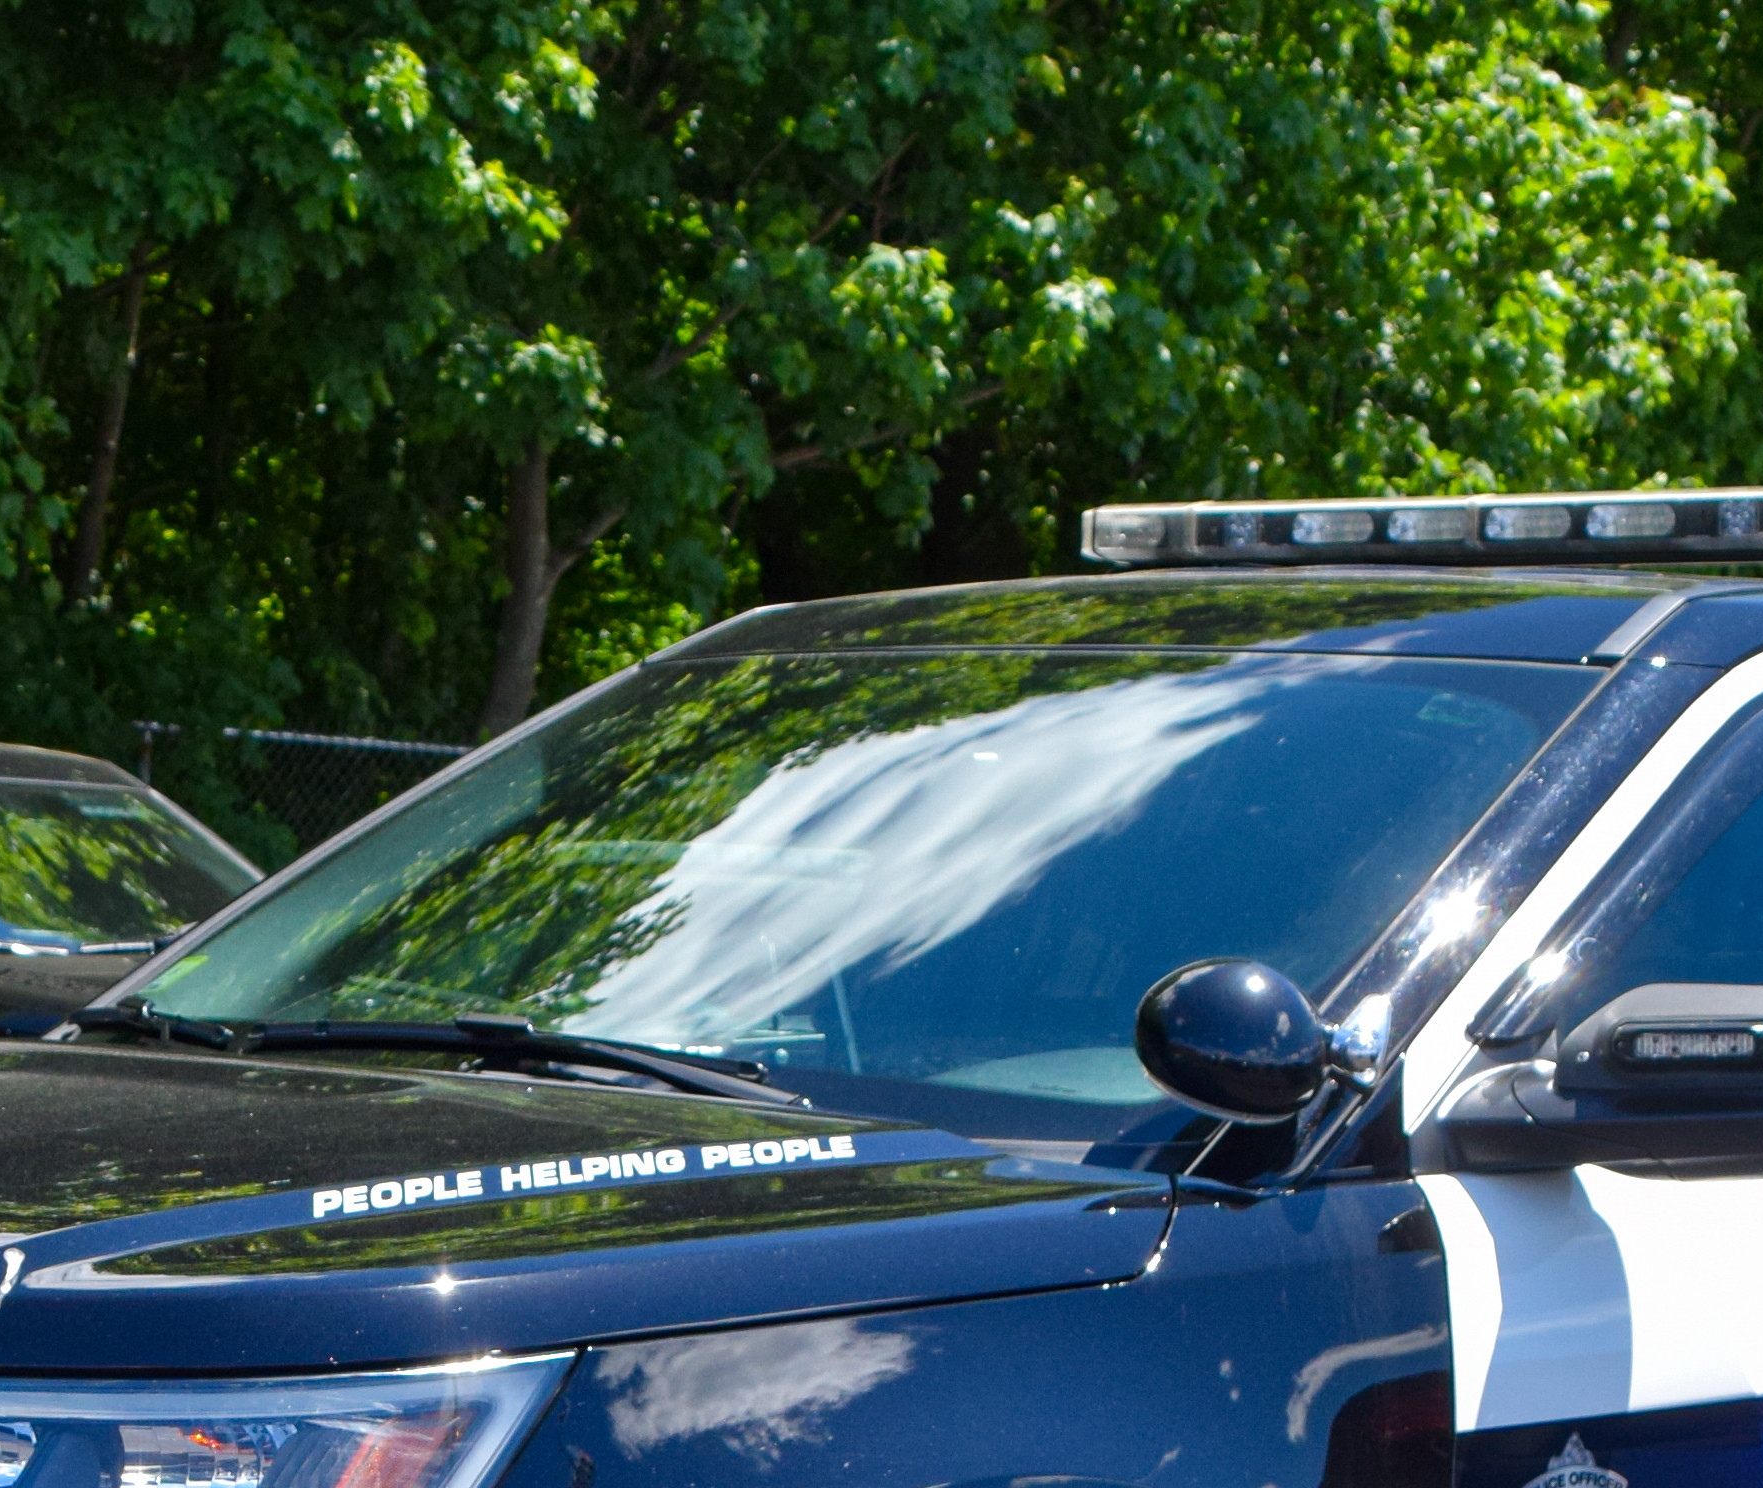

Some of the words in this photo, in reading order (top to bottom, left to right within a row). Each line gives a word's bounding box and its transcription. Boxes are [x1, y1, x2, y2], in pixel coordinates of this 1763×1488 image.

[312, 1170, 484, 1219] PEOPLE
[500, 1149, 686, 1193] HELPING
[700, 1134, 857, 1171] PEOPLE
